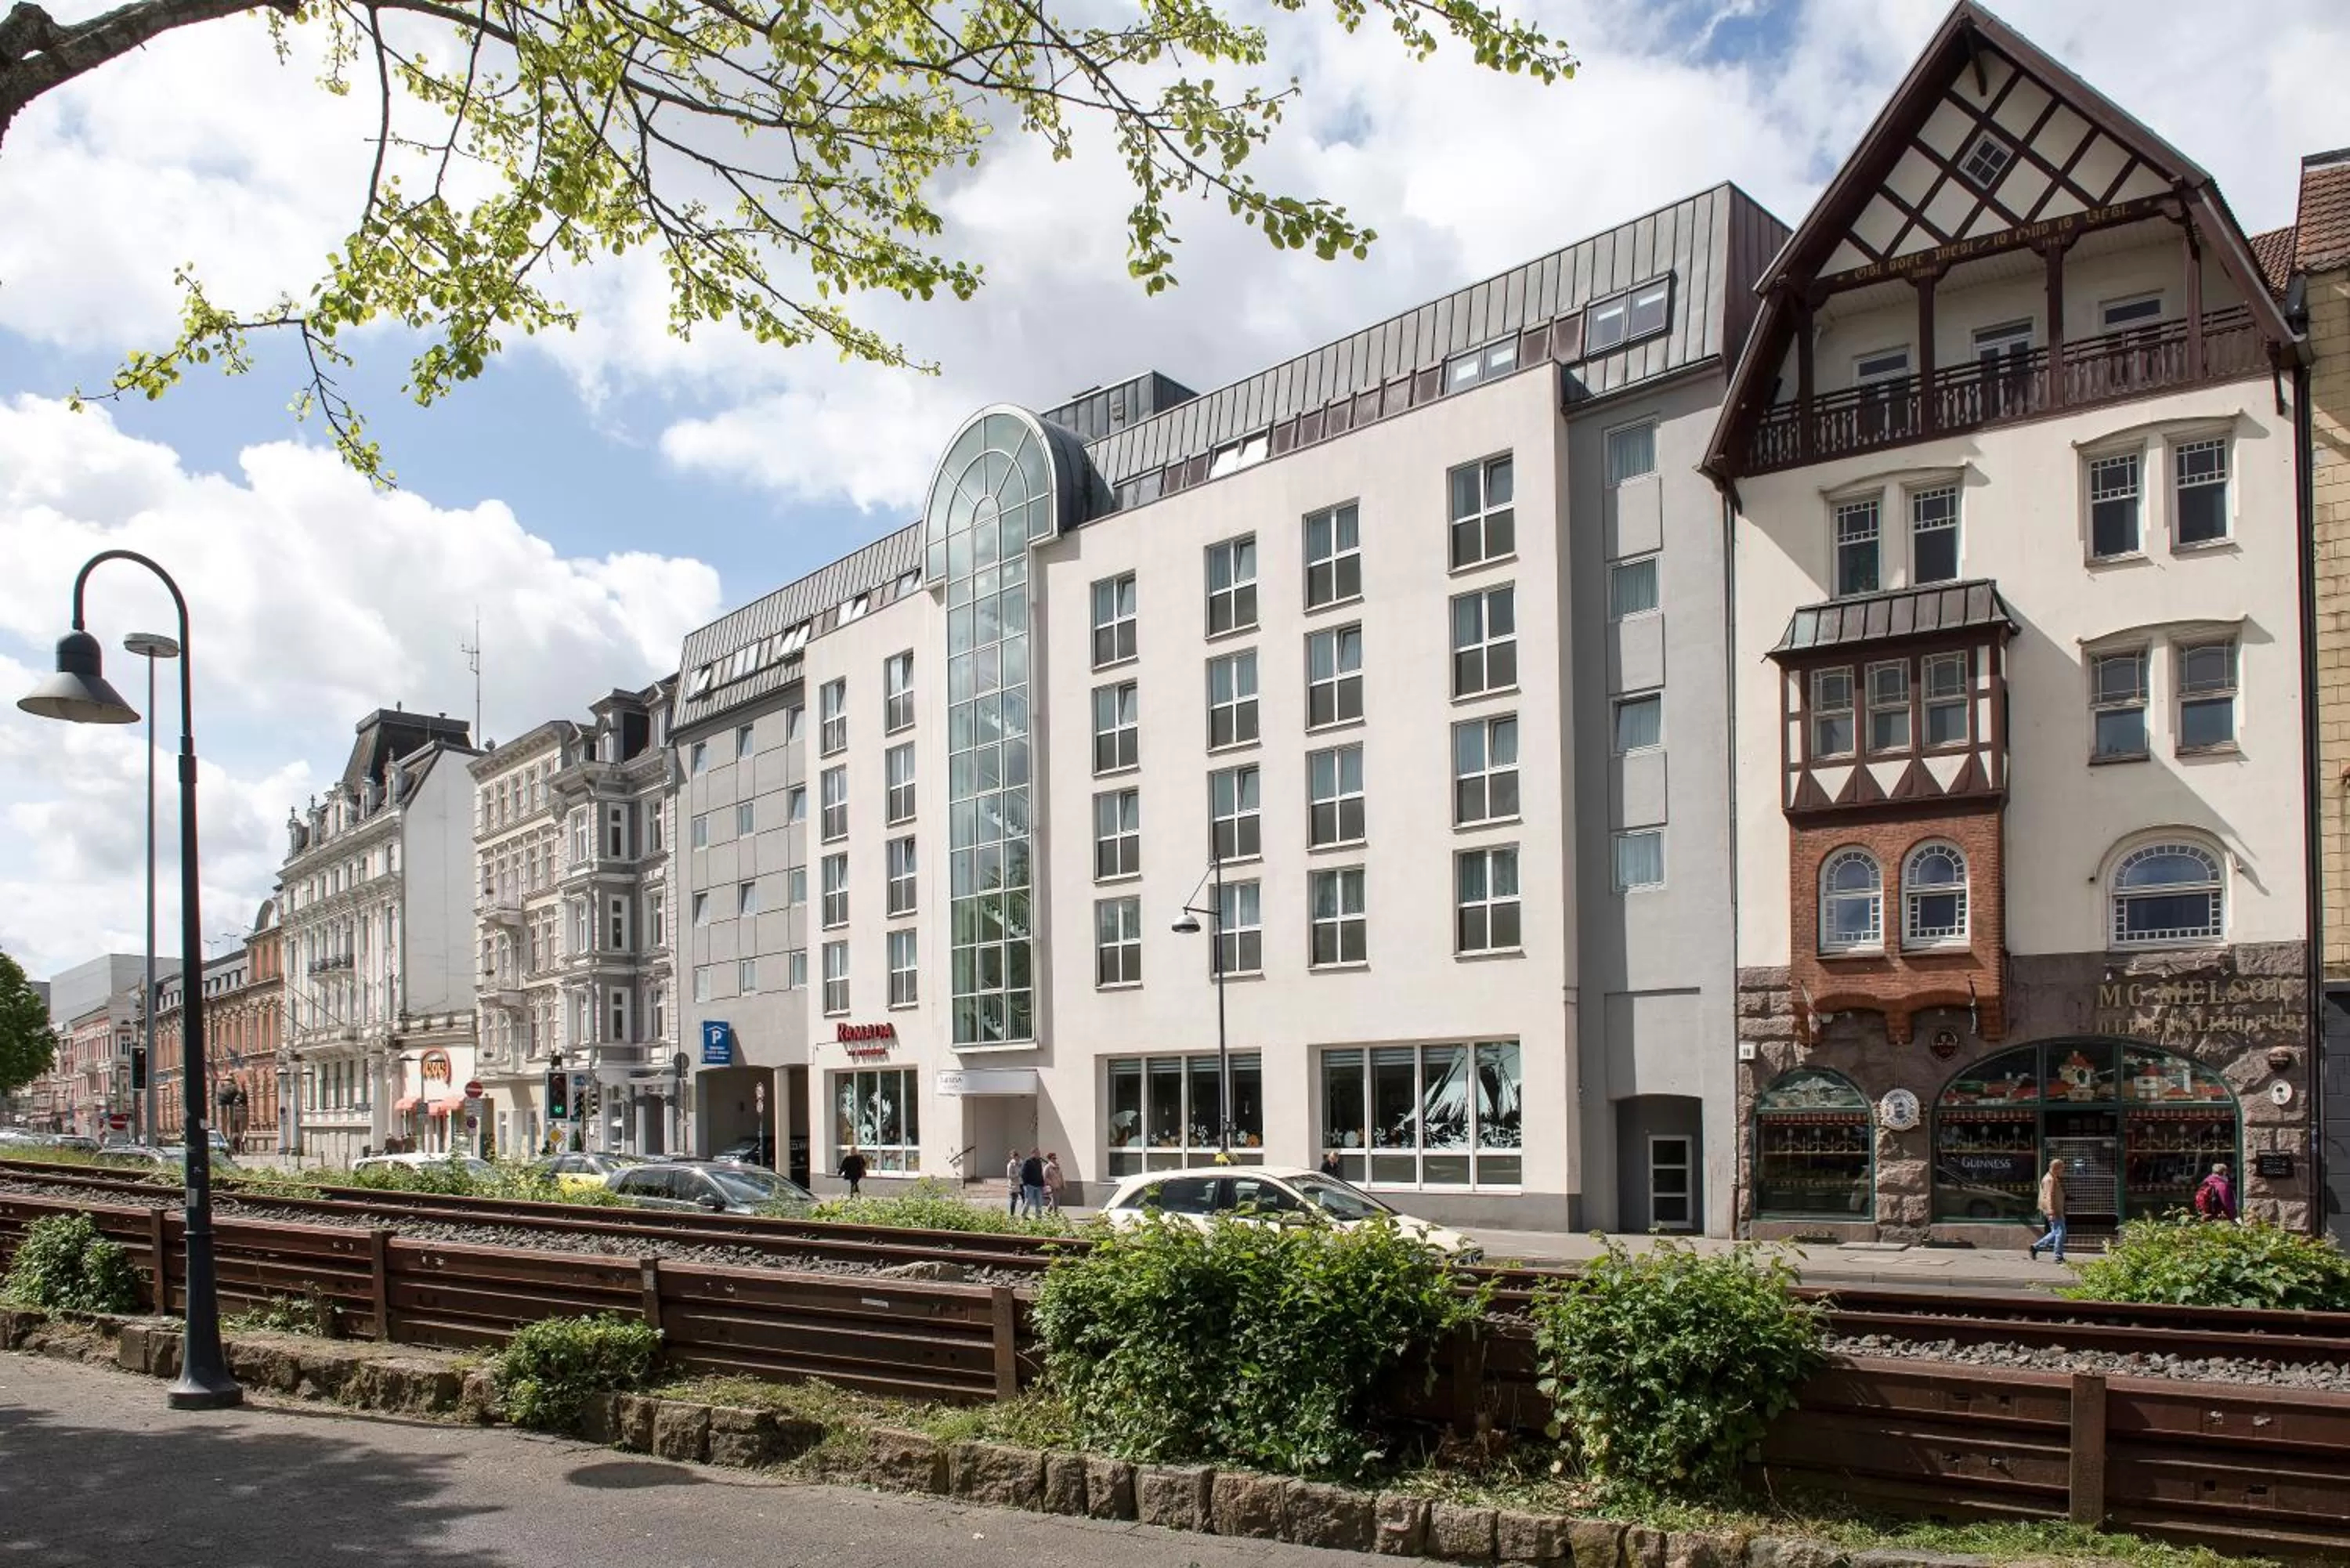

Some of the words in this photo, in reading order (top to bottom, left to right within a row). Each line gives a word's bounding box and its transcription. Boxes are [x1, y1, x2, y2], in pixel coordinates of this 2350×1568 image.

[711, 1030, 722, 1045] P
[837, 1022, 898, 1042] RAMADA
[1961, 1157, 2012, 1169] GUINNESS
